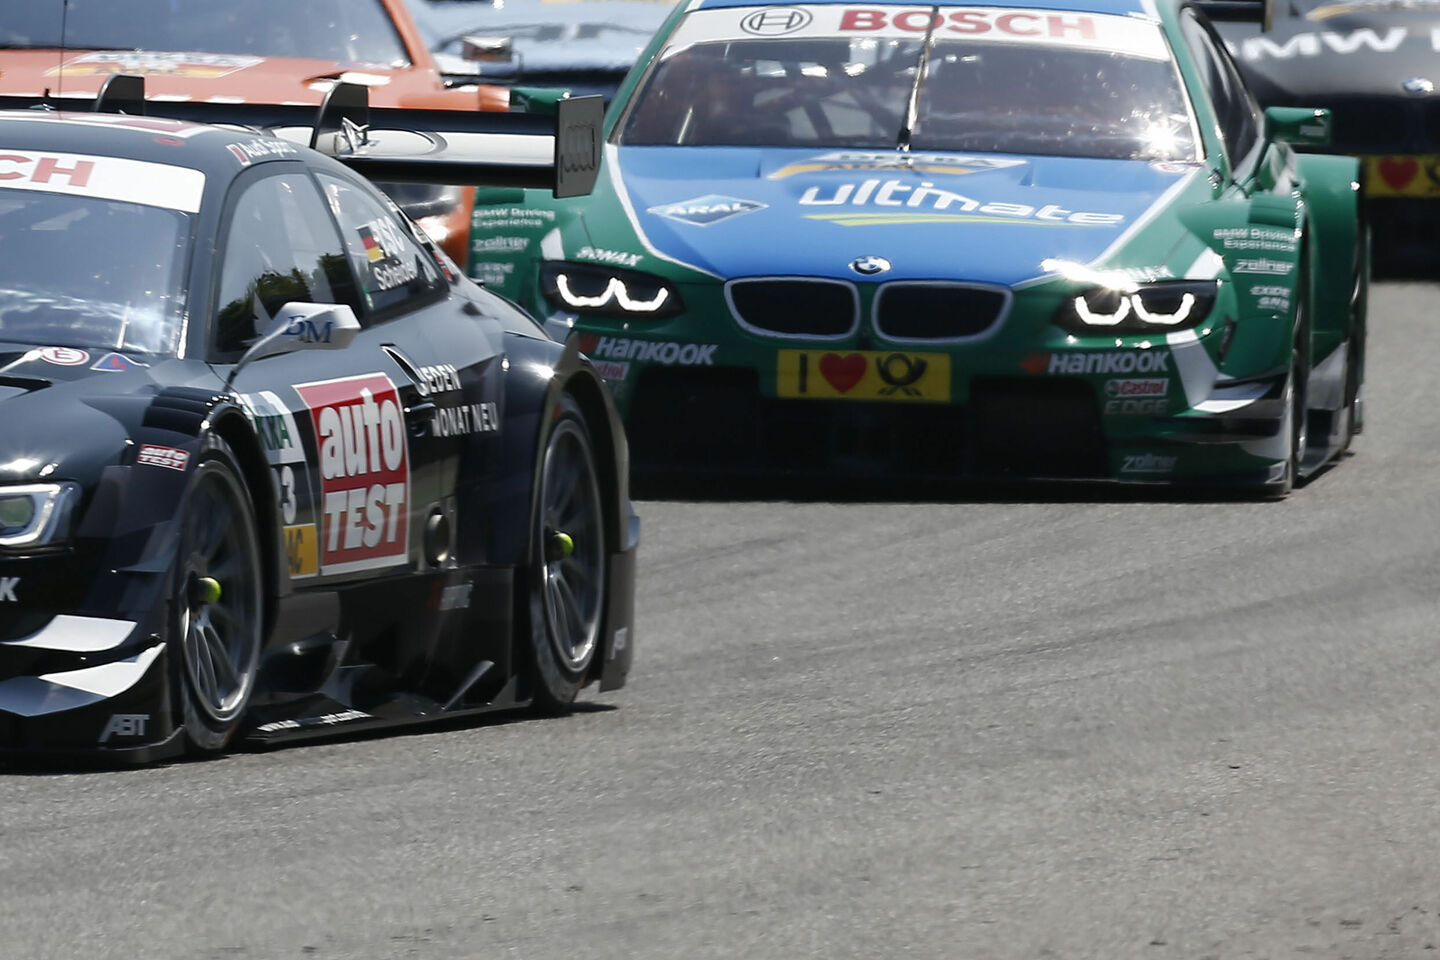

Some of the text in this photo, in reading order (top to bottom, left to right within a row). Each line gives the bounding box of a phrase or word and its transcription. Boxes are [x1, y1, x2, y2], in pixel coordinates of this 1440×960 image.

[838, 9, 1097, 40] BOSCH
[798, 178, 1125, 226] ultimate
[319, 387, 404, 480] auto
[471, 401, 499, 433] NEU
[324, 483, 406, 552] TEST
[100, 713, 150, 742] ABT
